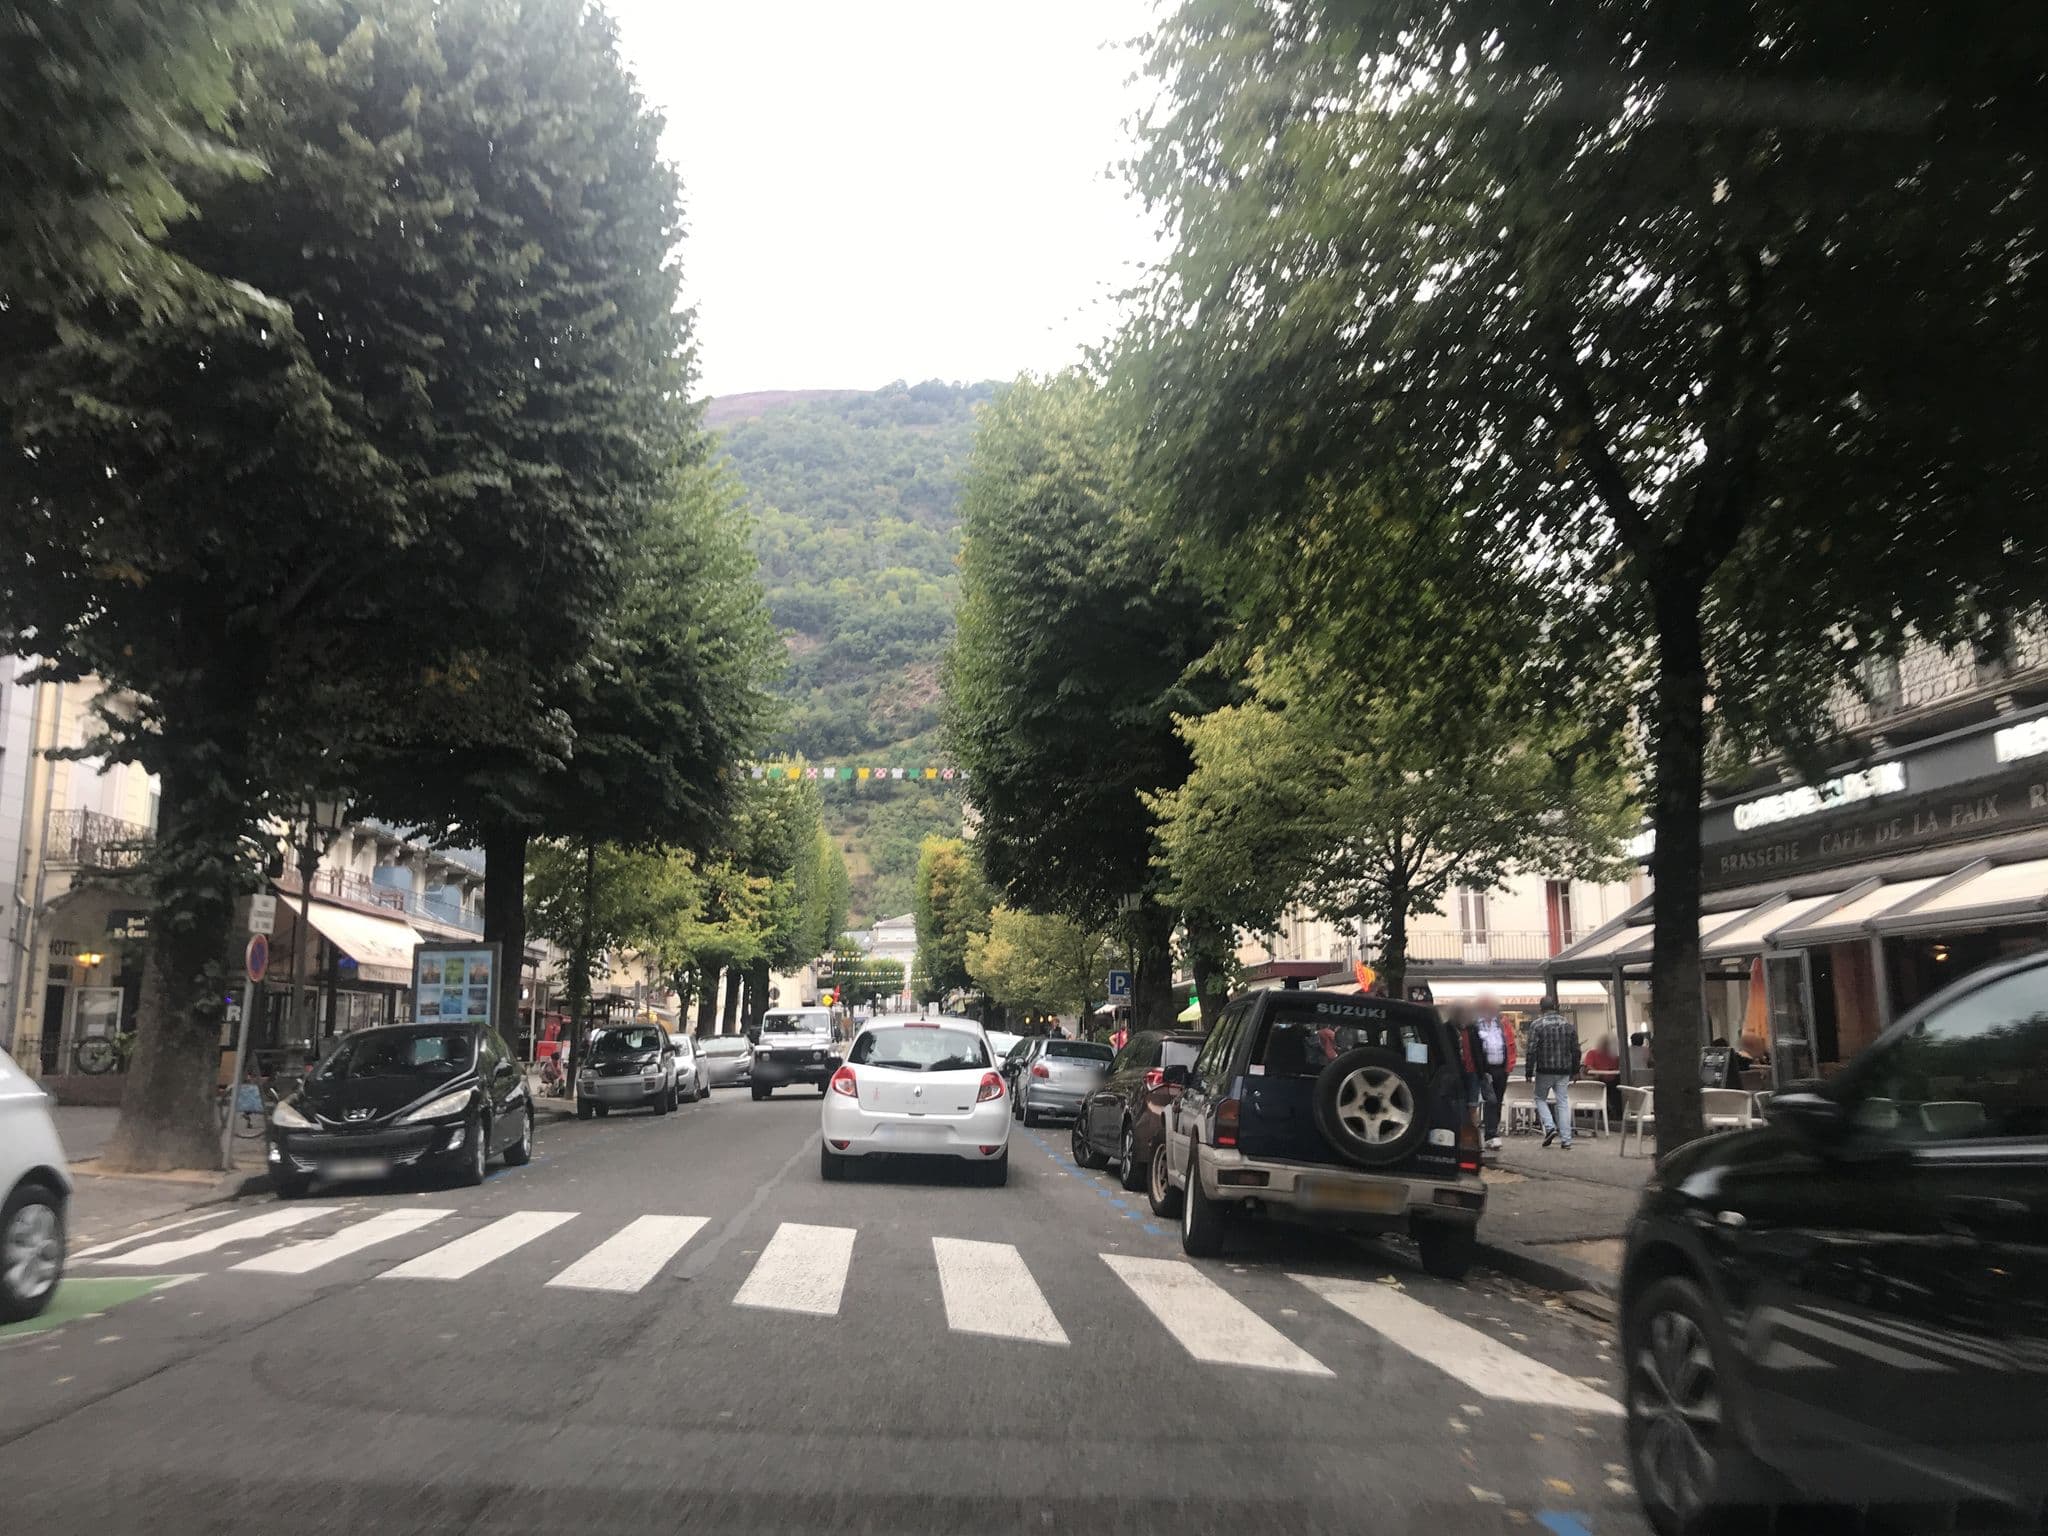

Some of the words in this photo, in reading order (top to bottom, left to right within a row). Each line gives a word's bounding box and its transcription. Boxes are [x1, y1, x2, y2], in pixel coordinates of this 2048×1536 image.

[1721, 840, 1800, 874] BRASSERIE
[1875, 818, 1902, 844] DE
[1914, 810, 1939, 836] LA
[1951, 793, 2000, 830] PAIX
[1115, 975, 1126, 992] P
[1316, 1001, 1387, 1020] SUZUKI
